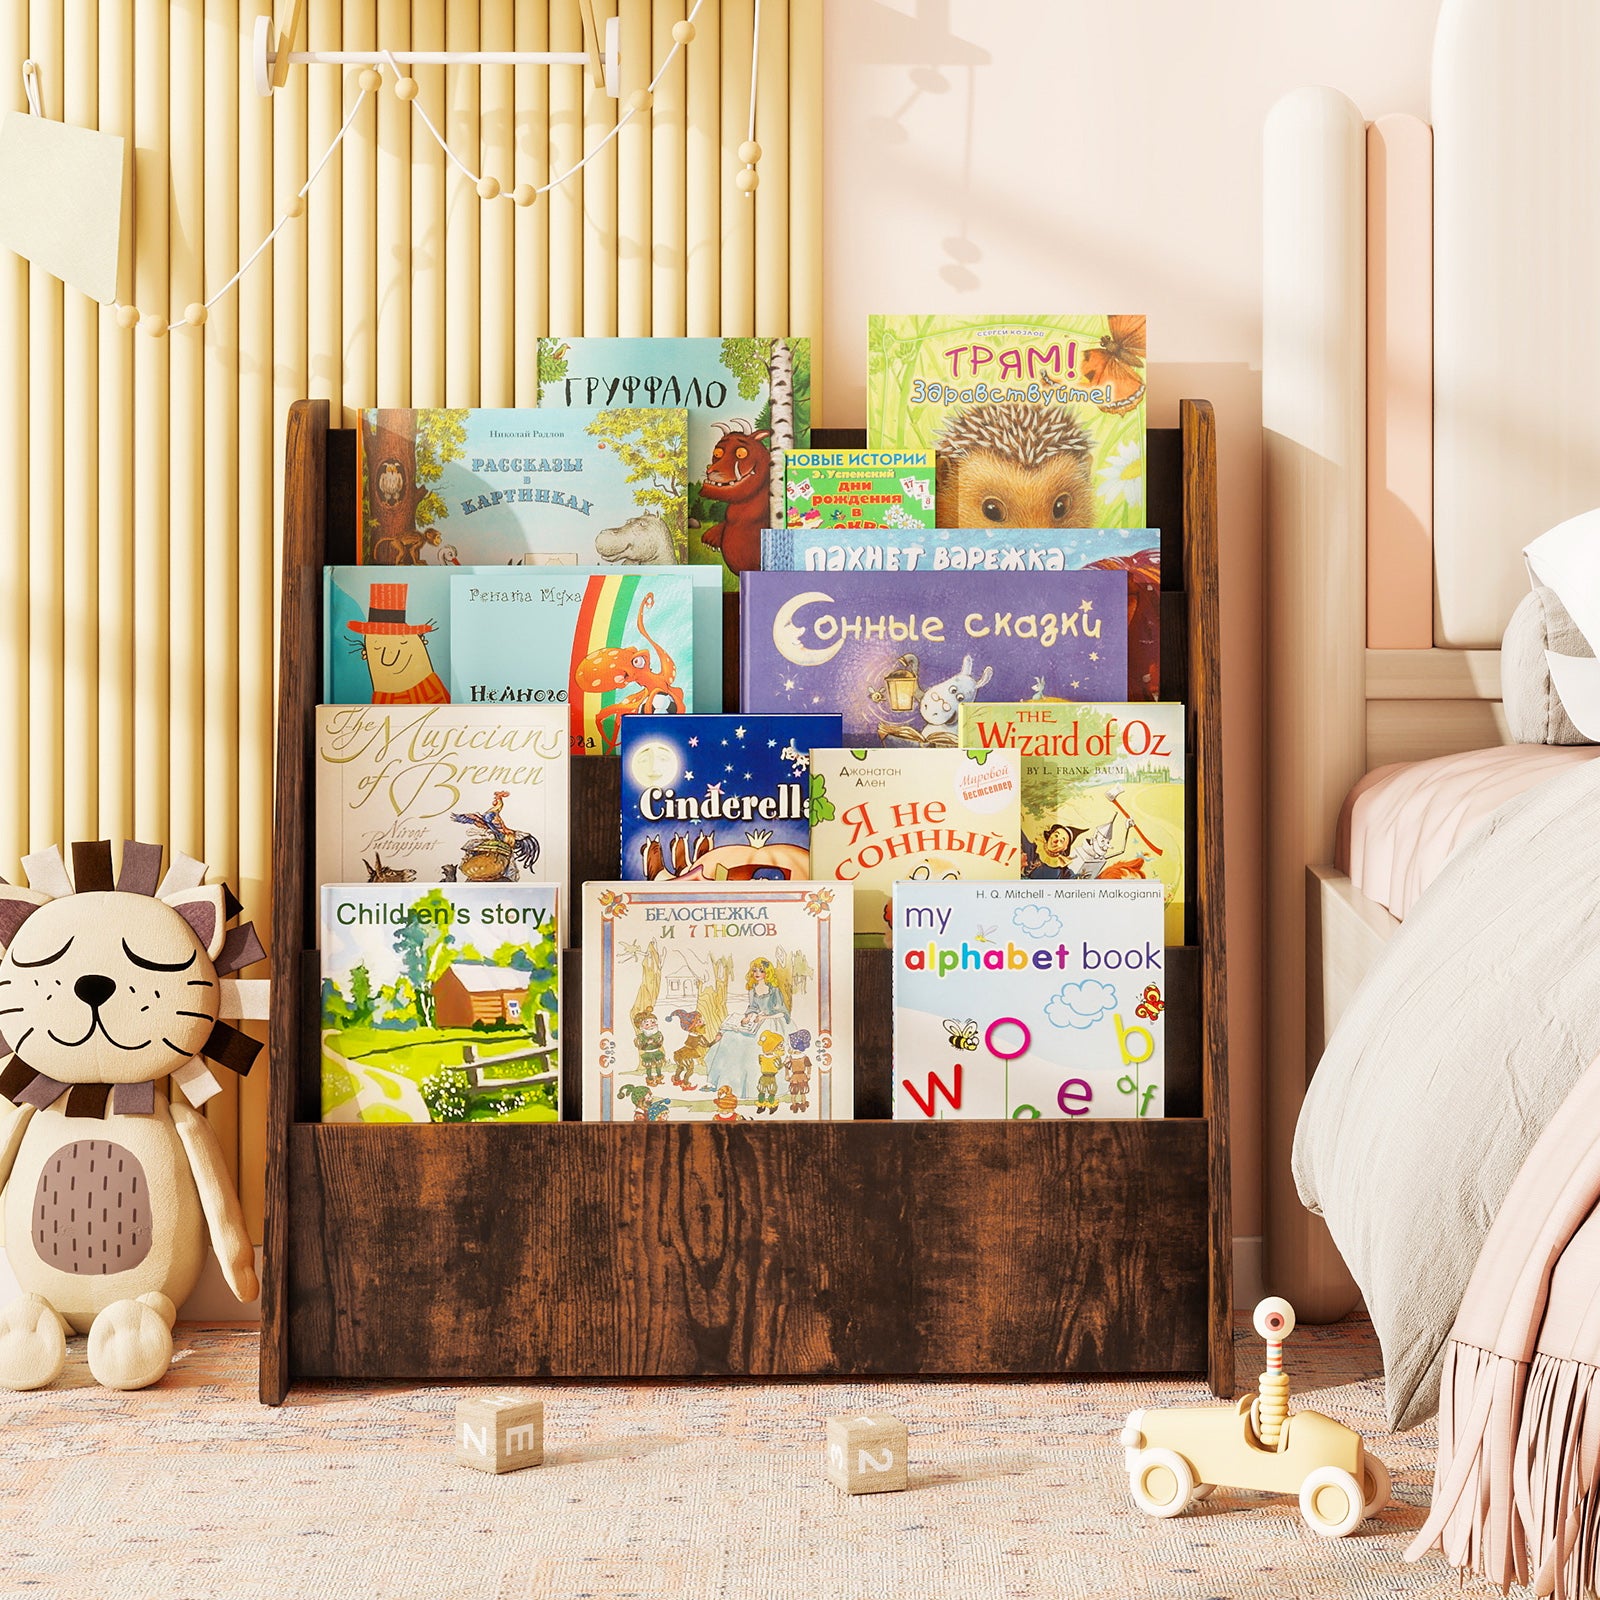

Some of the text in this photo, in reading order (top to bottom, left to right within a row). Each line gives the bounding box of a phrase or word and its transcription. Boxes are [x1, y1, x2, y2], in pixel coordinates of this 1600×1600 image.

[944, 342, 1076, 380] ТРЯМ!
[565, 375, 727, 408] ГРУФФАЛО
[911, 380, 1111, 406] Здравствуйте!
[489, 429, 565, 438] Николай Радлов
[471, 458, 583, 472] РАССКАЗЫ
[786, 453, 927, 467] НОВЫЕ ИСТОРИИ
[812, 469, 895, 479] Э. Успенский
[460, 488, 594, 516] КАРТИНКАХ
[812, 494, 903, 506] рождения
[469, 588, 582, 606] Рената Муха
[773, 591, 1102, 666] Сонные сказки
[470, 685, 568, 703] Немного
[1016, 711, 1057, 723] THE
[321, 707, 564, 763] The Musicians
[977, 719, 1173, 757] Wizard of Oz
[839, 766, 902, 777] Джонатан
[960, 765, 1009, 788] Мировой
[1026, 766, 1124, 775] BY L. FRANK BAUM
[349, 752, 544, 818] of Bremen
[855, 778, 886, 788] Ален
[840, 802, 879, 846] Я
[976, 890, 988, 899] H.
[990, 889, 1002, 900] Q.
[1004, 889, 1044, 899] Mitchell
[1054, 889, 1096, 899] Marileni
[1099, 889, 1162, 901] Malkogianni
[336, 902, 547, 930] Children's story
[646, 906, 770, 922] БЕЛОСНЕЖКА
[905, 907, 952, 935] my
[660, 923, 777, 939] И 7 ГНОМОВ
[905, 941, 1162, 978] alphabet book
